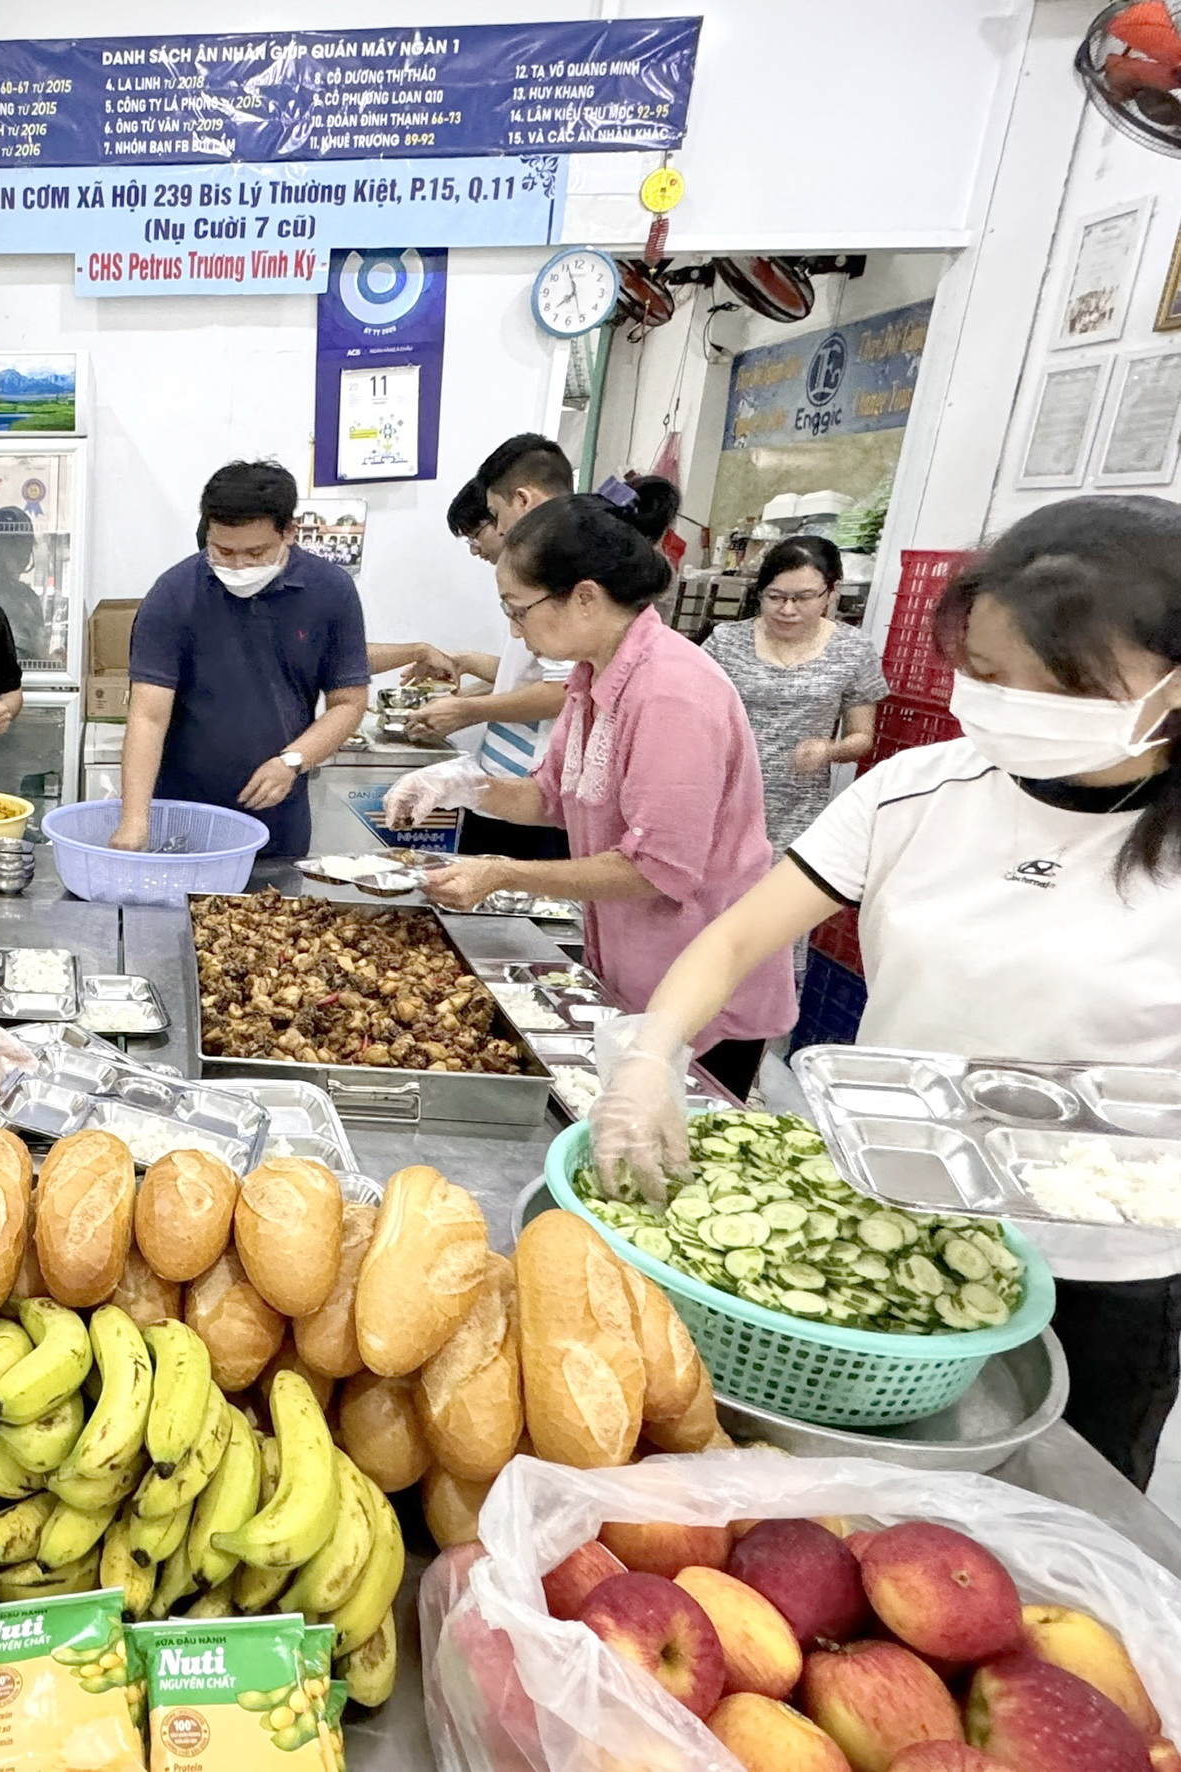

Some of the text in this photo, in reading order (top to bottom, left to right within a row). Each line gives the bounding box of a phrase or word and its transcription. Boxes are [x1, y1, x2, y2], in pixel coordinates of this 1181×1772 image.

[102, 38, 460, 65] DANH SÁCH ÂN NHÂN GIÚP QUÁN MÂY NGÀN 1
[327, 67, 341, 84] CÔ
[344, 68, 384, 84] DƯƠNG
[515, 60, 640, 81] 12. TẠ VÕ QUANG MINH
[0, 81, 28, 94] 60-67
[46, 80, 72, 93] 2015
[106, 75, 204, 91] 4. LA LINH 2018
[325, 90, 443, 105] CÔ LOAN Q10
[513, 85, 594, 100] 13. HUY KHANG
[31, 101, 57, 115] 2015
[105, 100, 114, 113] 5.
[117, 96, 146, 113] CÔNG
[148, 98, 162, 111] TY
[164, 95, 178, 111] LÁ
[236, 95, 262, 108] 2015
[311, 116, 323, 128] 10.
[360, 111, 388, 126] ĐÌNH
[391, 112, 429, 129] THẠNH
[431, 111, 462, 125] 66-73
[510, 104, 669, 123] 14. LÂM 92-95
[21, 123, 47, 136] 2016
[104, 121, 113, 134] 6.
[116, 117, 138, 133] ÔNG
[158, 117, 179, 132] VÂN
[197, 119, 223, 131] 2019
[321, 133, 435, 149] KHUÊ TRƯƠNG 89-92
[508, 126, 632, 144] 15. VÀ CÁC ÂN NHÂN
[15, 143, 41, 156] 2016
[104, 138, 189, 156] 7. NHÓM BẠN FB
[22, 184, 69, 210] CƠM
[76, 180, 105, 209] XÃ
[112, 179, 147, 213] HỘI
[154, 183, 193, 208] 239
[199, 182, 232, 208] Bis
[238, 180, 262, 208] Lý
[269, 180, 346, 206] Thường
[353, 178, 403, 208] Kiệt,
[409, 176, 461, 204] P.15,
[468, 176, 515, 202] Q.11
[144, 214, 317, 245] (Nụ Cười 7 cũ)
[88, 248, 317, 283] CHS Petrus Trương Vĩnh Ký
[575, 260, 585, 269] 12
[550, 274, 559, 282] 10
[597, 274, 603, 282] 2
[543, 288, 550, 298] 9
[598, 288, 605, 298] 3
[544, 303, 550, 311] 8
[592, 303, 598, 311] 4
[553, 313, 559, 322] 7
[565, 316, 572, 326] 6
[579, 313, 586, 323] 5
[370, 375, 387, 396] 11
[795, 402, 842, 436] Enggic
[24, 1635, 52, 1646] CHẤT
[154, 1636, 227, 1647] SỮA ĐẬU NÀNH
[158, 1647, 226, 1676] Nuti
[160, 1672, 237, 1690] NGUYÊN CHẤT
[173, 1763, 203, 1772] Protein
